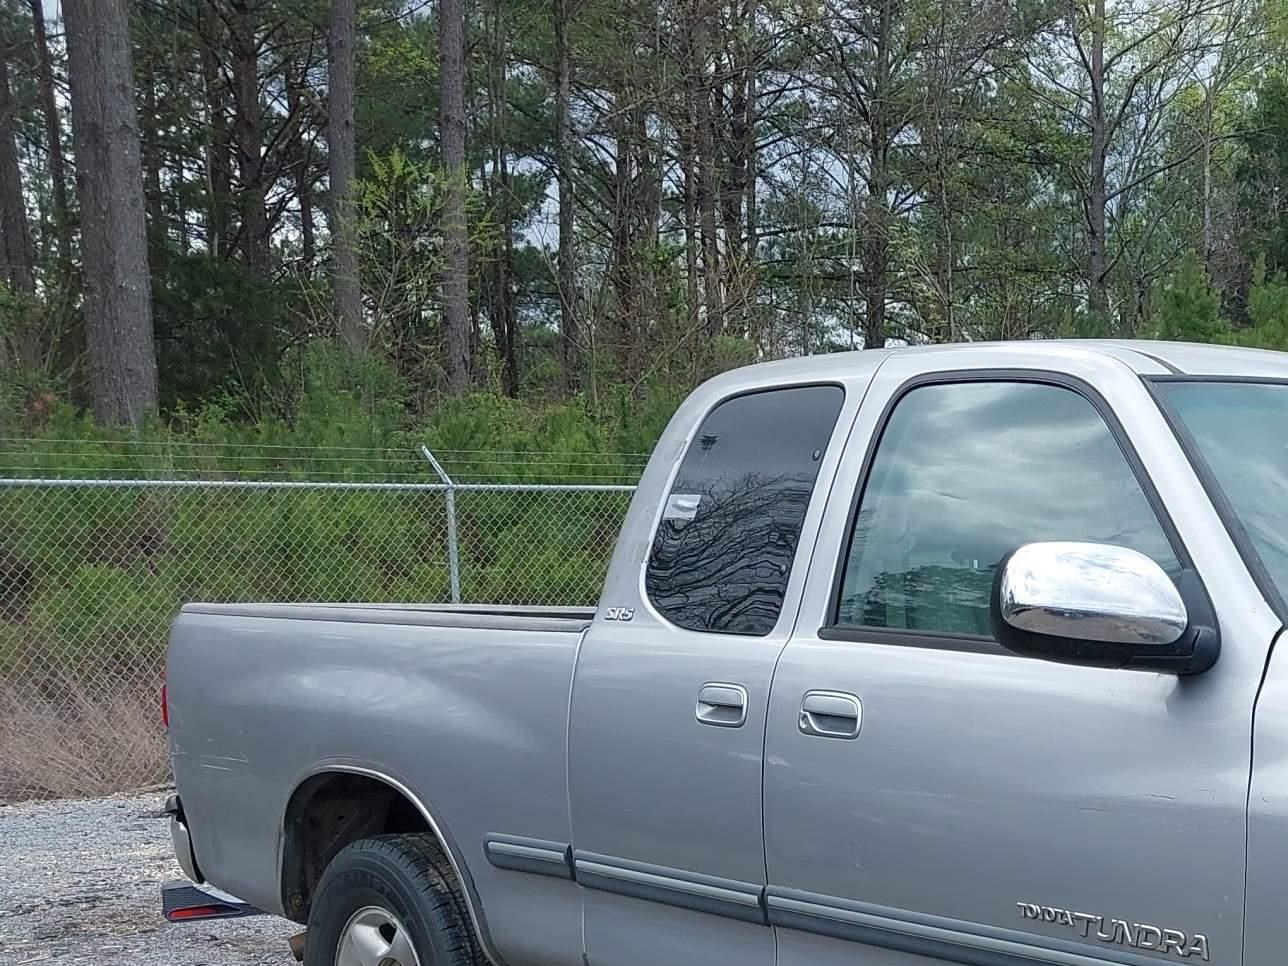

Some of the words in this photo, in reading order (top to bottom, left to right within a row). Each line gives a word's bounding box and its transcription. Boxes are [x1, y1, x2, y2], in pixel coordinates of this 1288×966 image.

[604, 607, 636, 621] SR5
[1017, 901, 1075, 927] TOYOTA
[1072, 911, 1211, 961] TUNDRA
